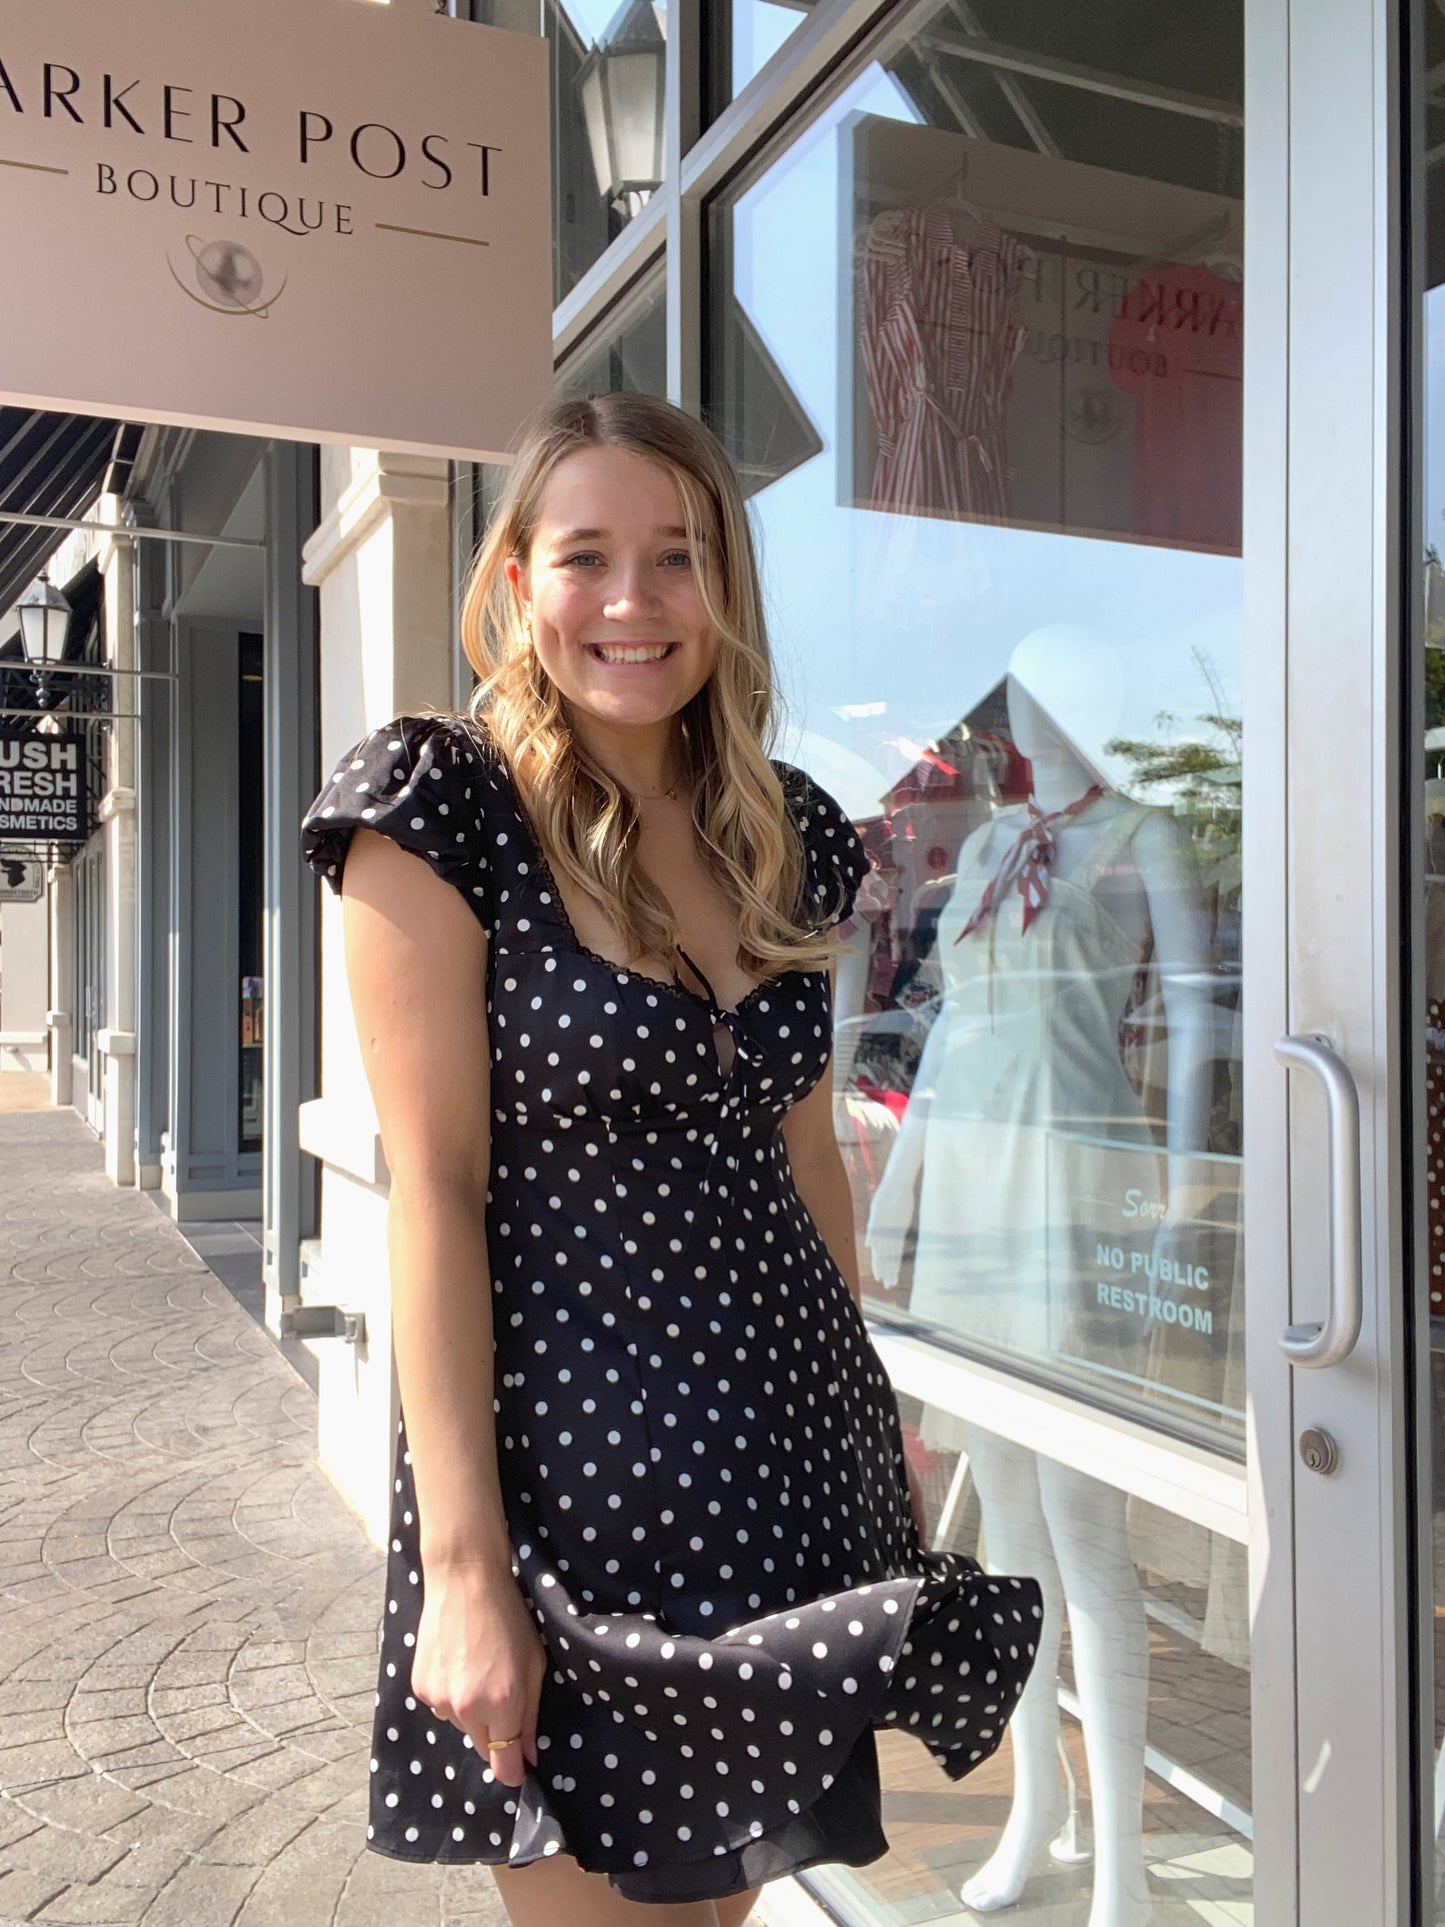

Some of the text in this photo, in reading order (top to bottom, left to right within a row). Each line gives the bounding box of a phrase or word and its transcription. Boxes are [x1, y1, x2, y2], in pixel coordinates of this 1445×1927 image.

[299, 111, 503, 196] POST
[96, 163, 354, 236] BOUTIQUE
[0, 741, 77, 770] USH
[1096, 1243, 1209, 1290] NO PUBLIC
[1097, 1283, 1213, 1334] RESTROOM
